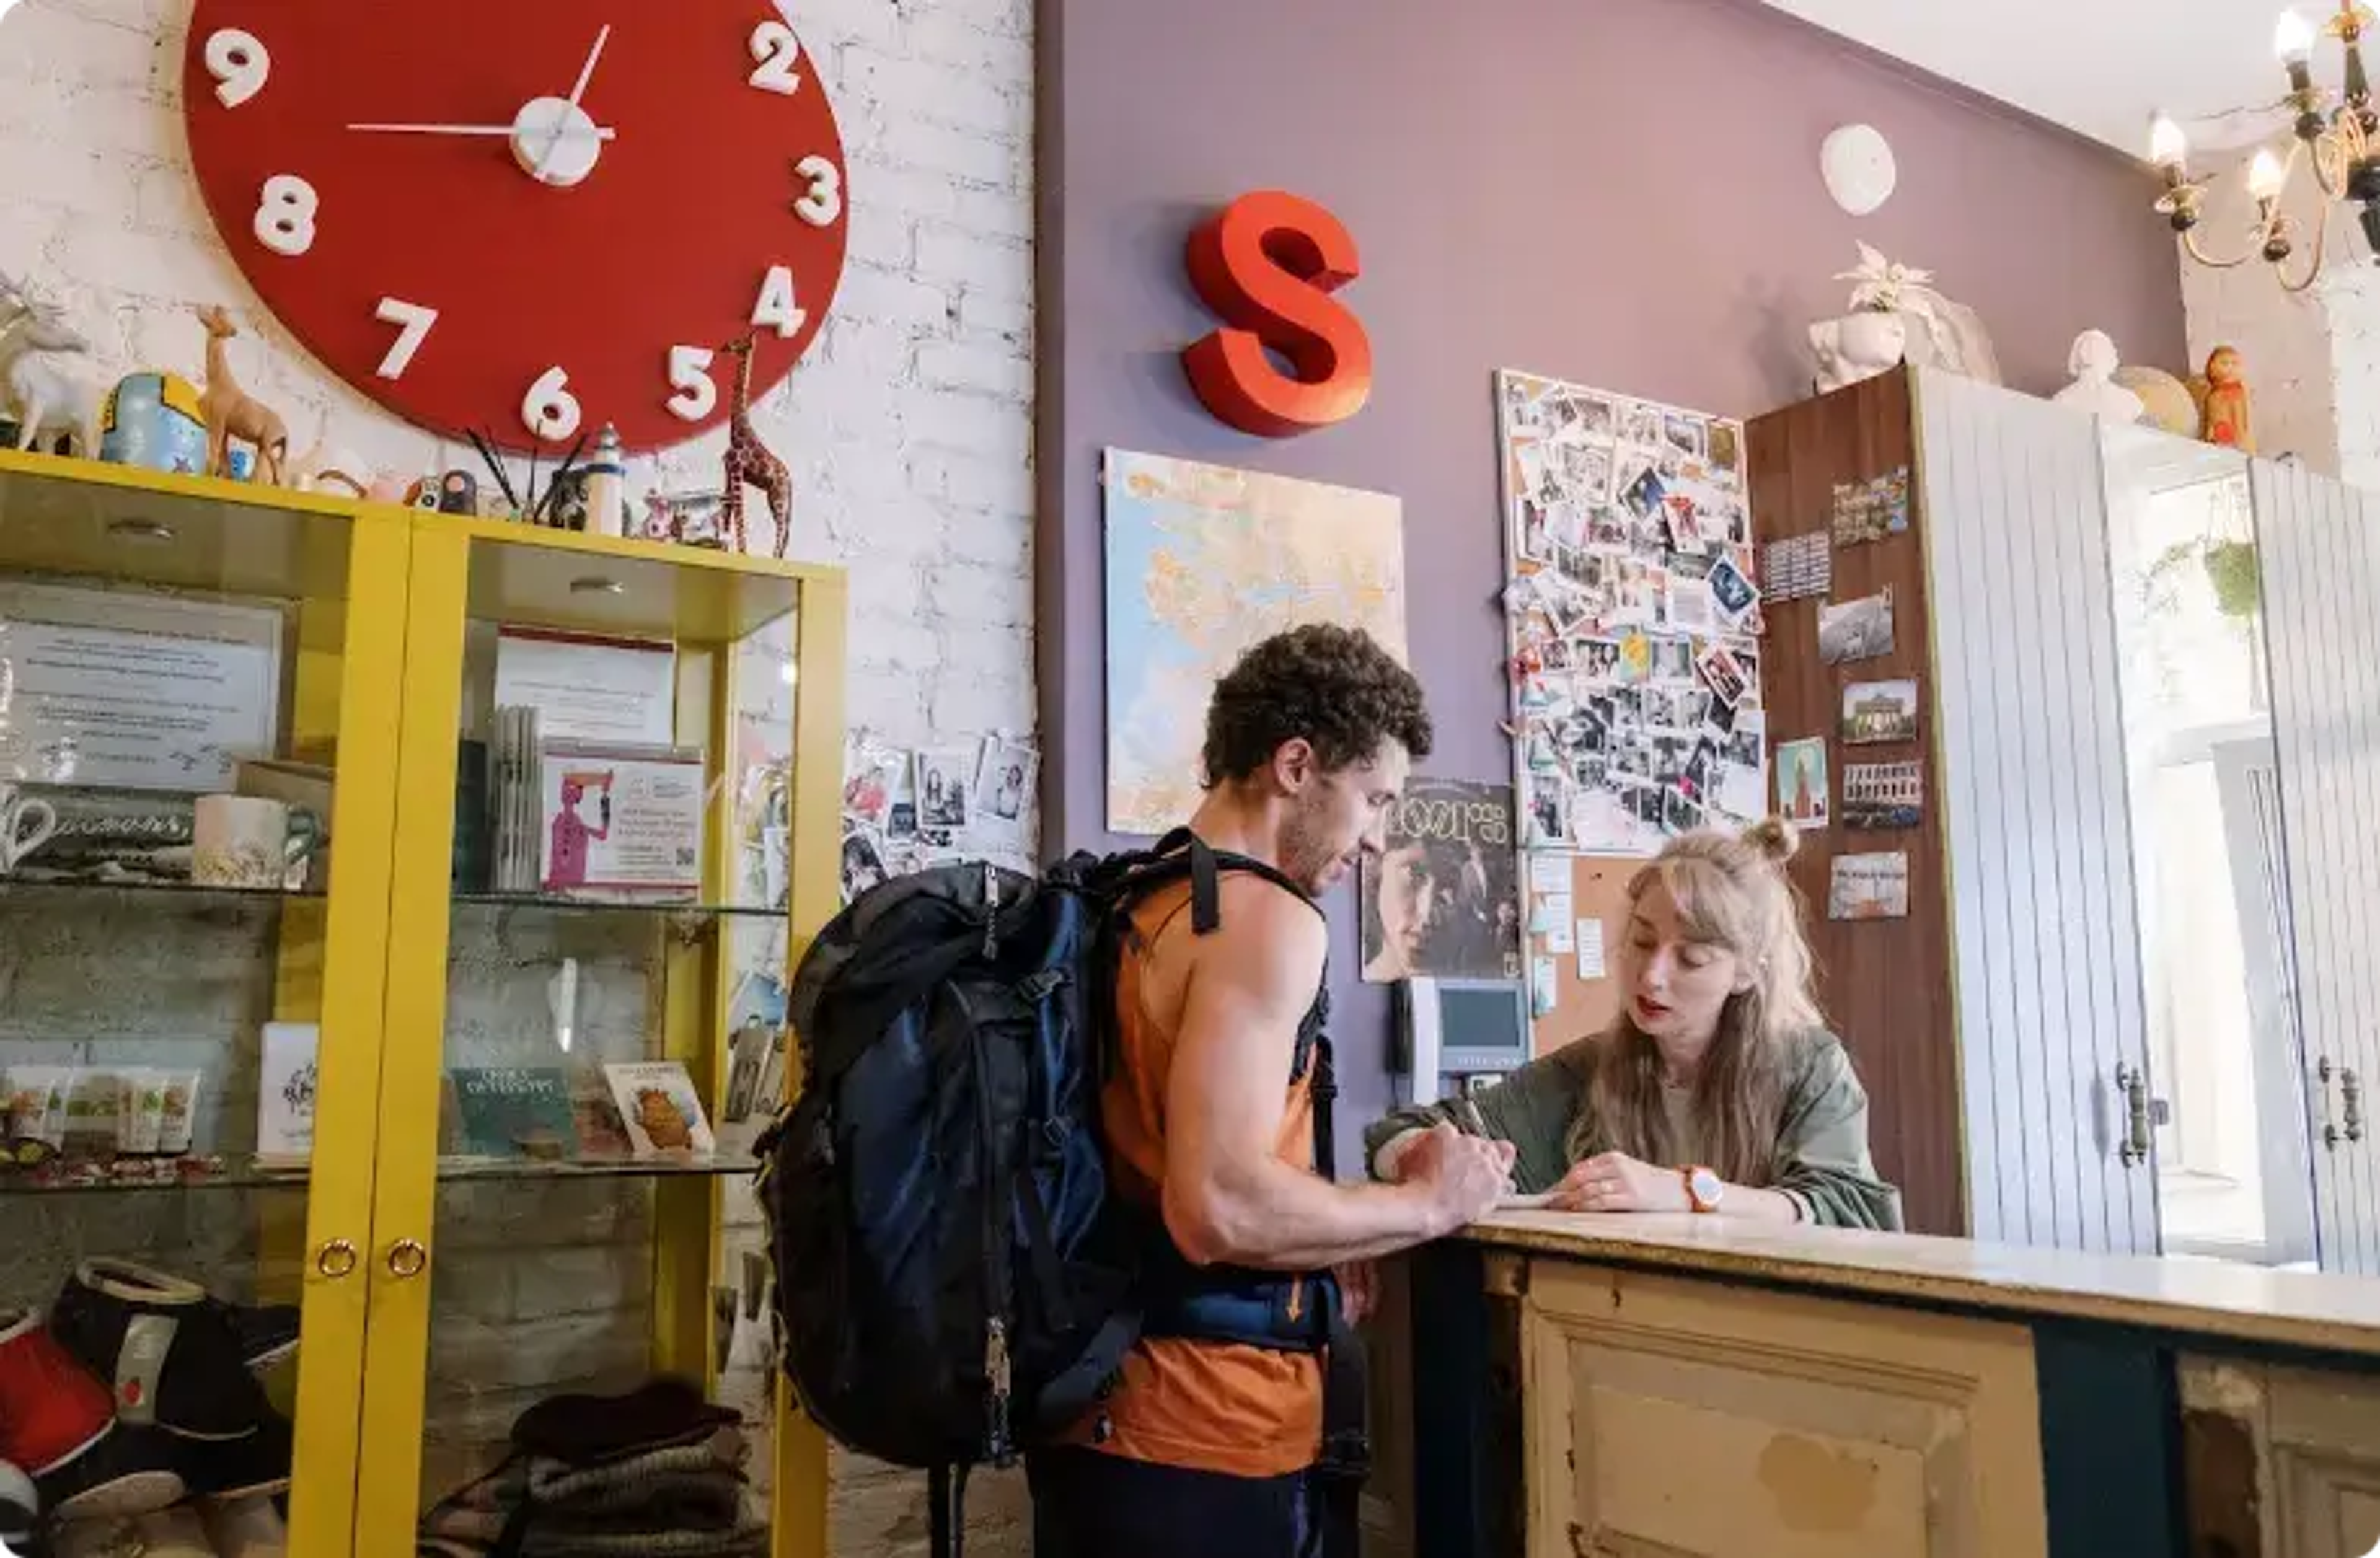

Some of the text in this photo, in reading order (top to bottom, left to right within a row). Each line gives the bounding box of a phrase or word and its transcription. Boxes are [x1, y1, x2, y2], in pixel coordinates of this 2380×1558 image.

[205, 29, 270, 108] 9
[748, 20, 801, 95] 2
[253, 175, 319, 256] 8
[793, 154, 841, 226] 3
[376, 297, 438, 379] 7
[751, 265, 807, 338] 4
[1185, 189, 1373, 436] S
[522, 366, 581, 441] 6
[667, 345, 717, 421] 5
